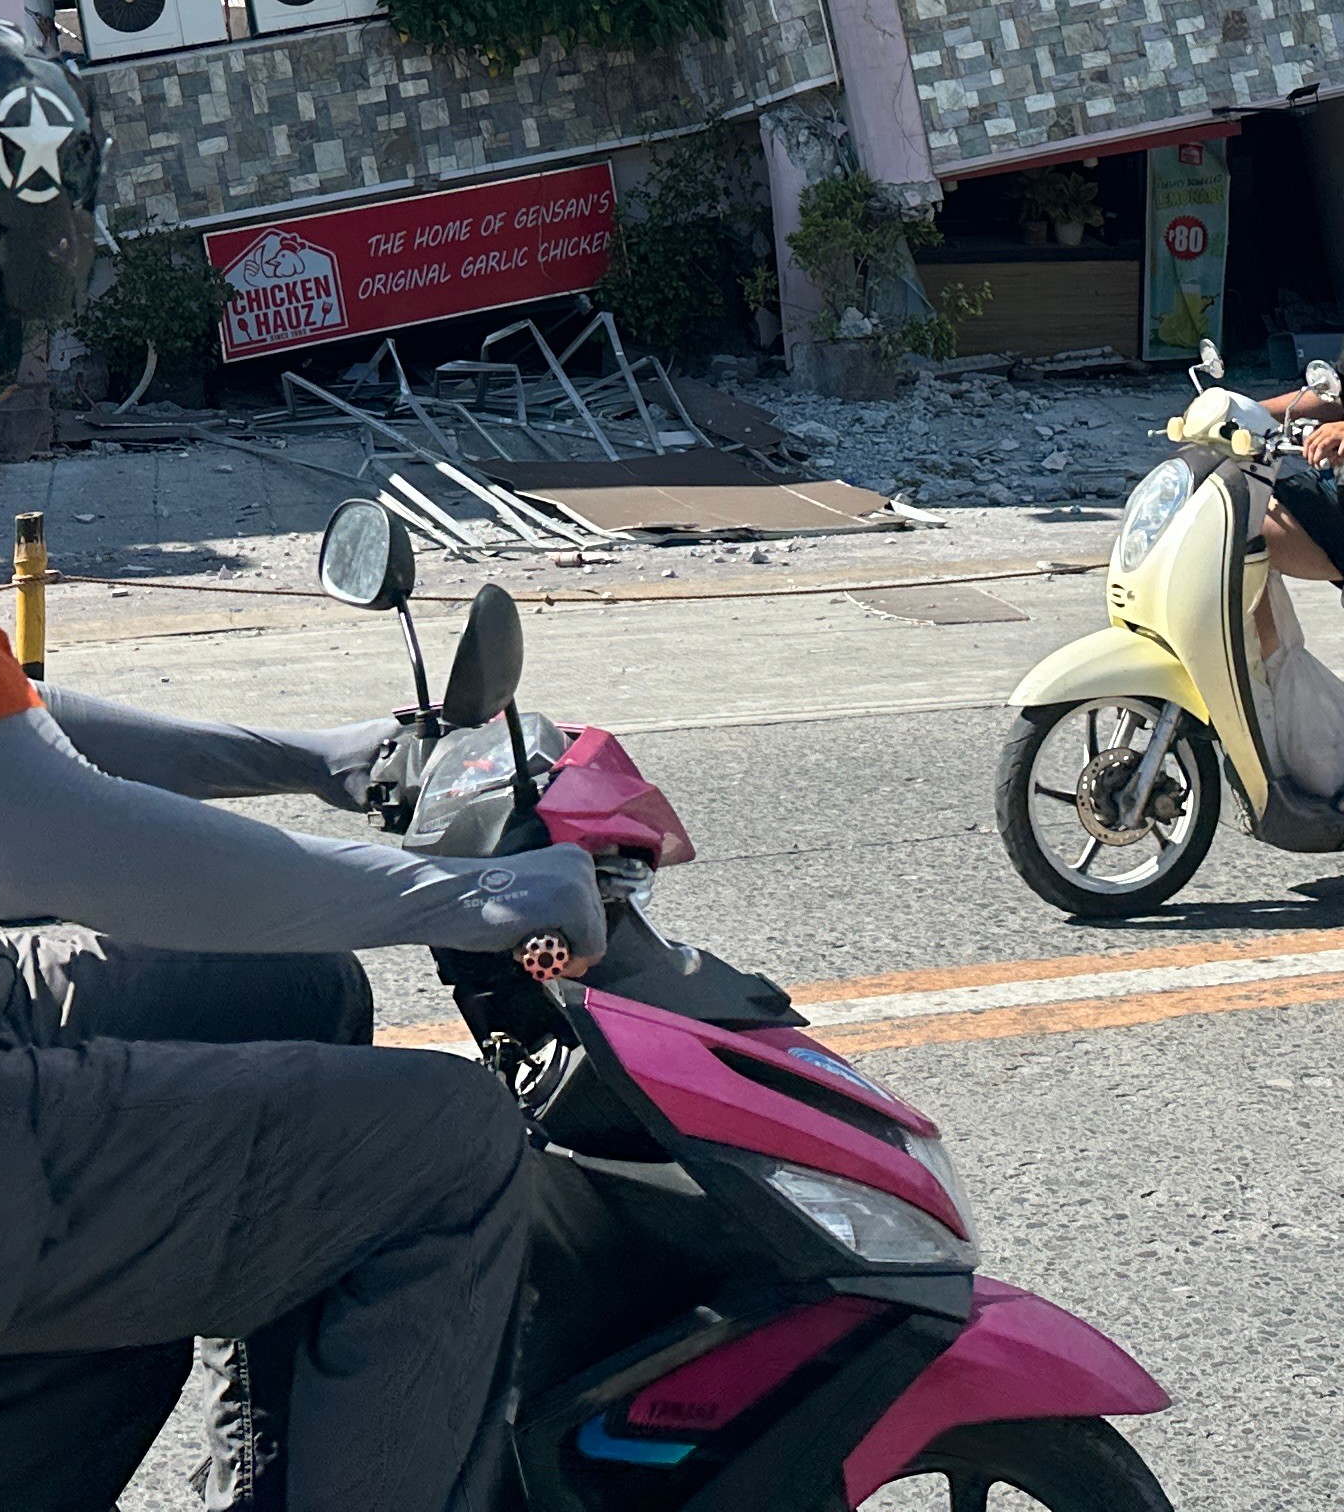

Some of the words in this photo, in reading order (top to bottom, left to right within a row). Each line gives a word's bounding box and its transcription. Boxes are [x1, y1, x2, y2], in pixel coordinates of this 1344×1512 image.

[1156, 184, 1224, 208] LEMONADE
[368, 231, 407, 257] THE
[414, 218, 473, 250] HOME
[480, 211, 507, 237] OF
[514, 190, 611, 229] GENSAN'S
[358, 262, 452, 300] ORIGINAL
[461, 247, 528, 279] GARLIC
[231, 274, 332, 316] CHICKEN
[255, 303, 317, 337] HAUZ
